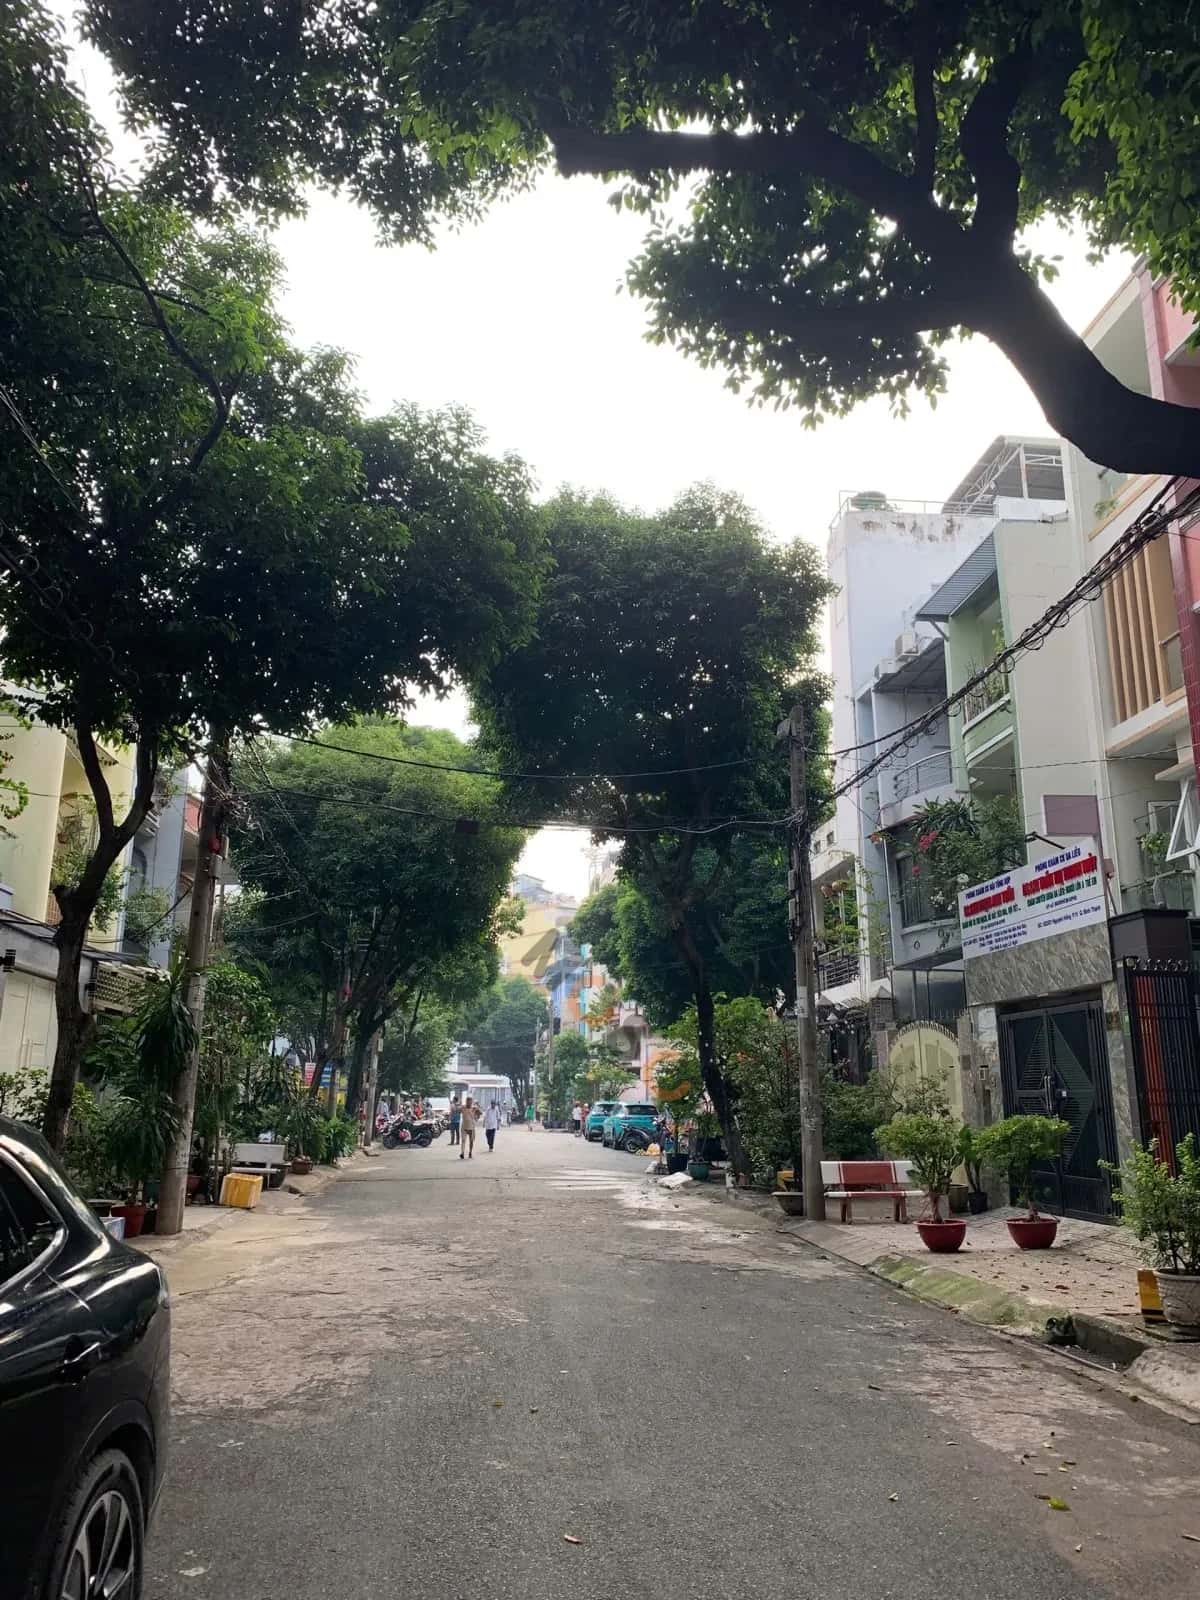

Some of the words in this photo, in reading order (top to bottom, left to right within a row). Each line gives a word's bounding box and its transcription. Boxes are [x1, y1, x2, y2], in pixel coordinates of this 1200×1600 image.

[1035, 862, 1047, 873] PHÒNG
[1048, 856, 1060, 867] KHÁM
[1059, 854, 1065, 863] CK
